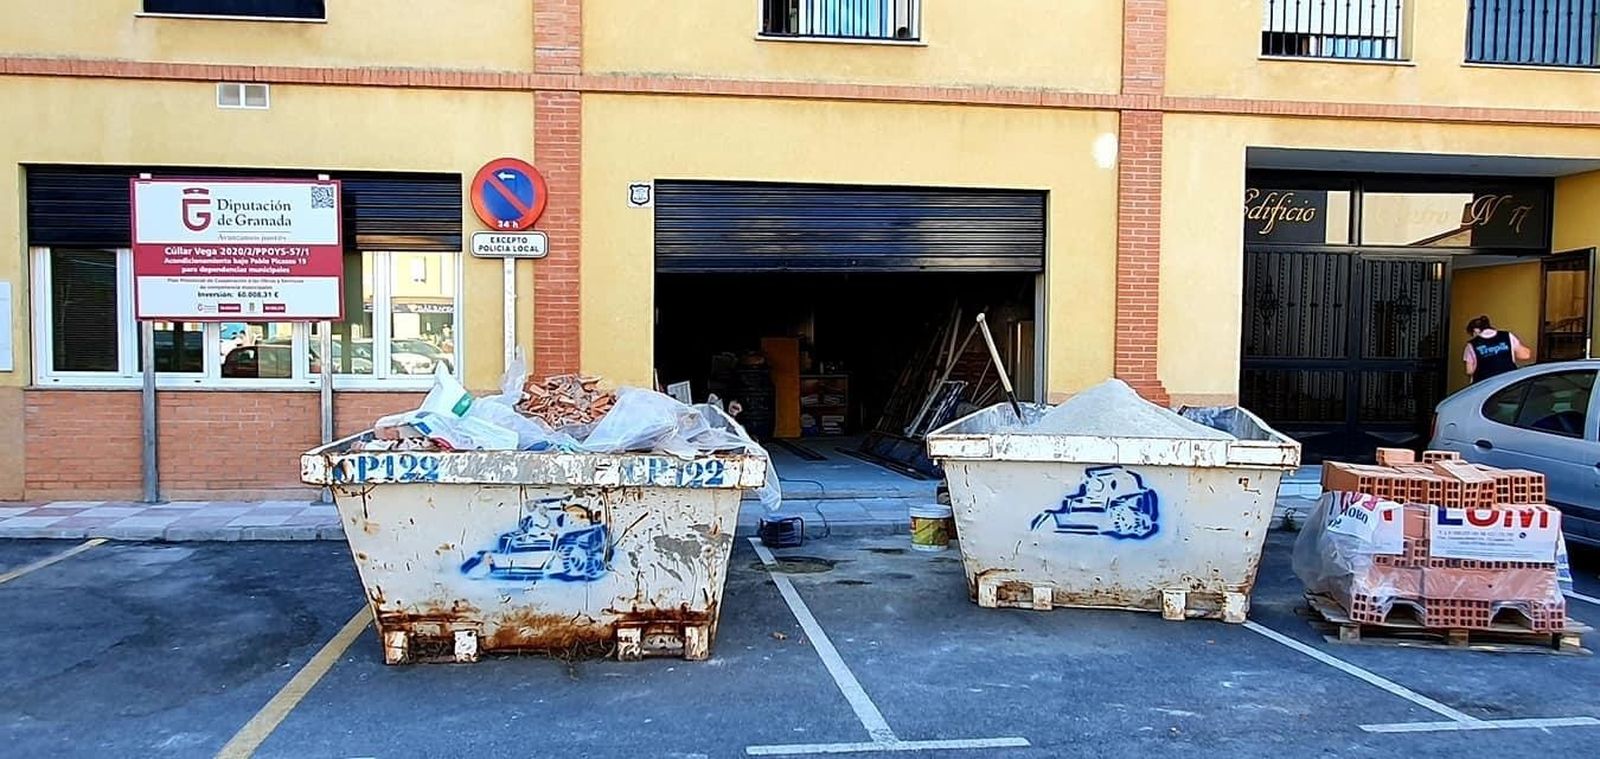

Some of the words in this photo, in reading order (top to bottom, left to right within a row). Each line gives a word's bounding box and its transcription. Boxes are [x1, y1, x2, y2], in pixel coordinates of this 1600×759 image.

[217, 198, 292, 213] Diputación
[217, 214, 233, 226] de
[235, 214, 292, 226] Granada
[497, 220, 509, 228] 24
[512, 220, 519, 228] h
[490, 236, 528, 244] EXCEPTO
[164, 247, 194, 256] Cúllar
[194, 247, 217, 257] Vega
[512, 245, 540, 253] LOCAL
[181, 266, 198, 274] para
[199, 265, 248, 274] dependencias
[248, 266, 291, 275] municipales
